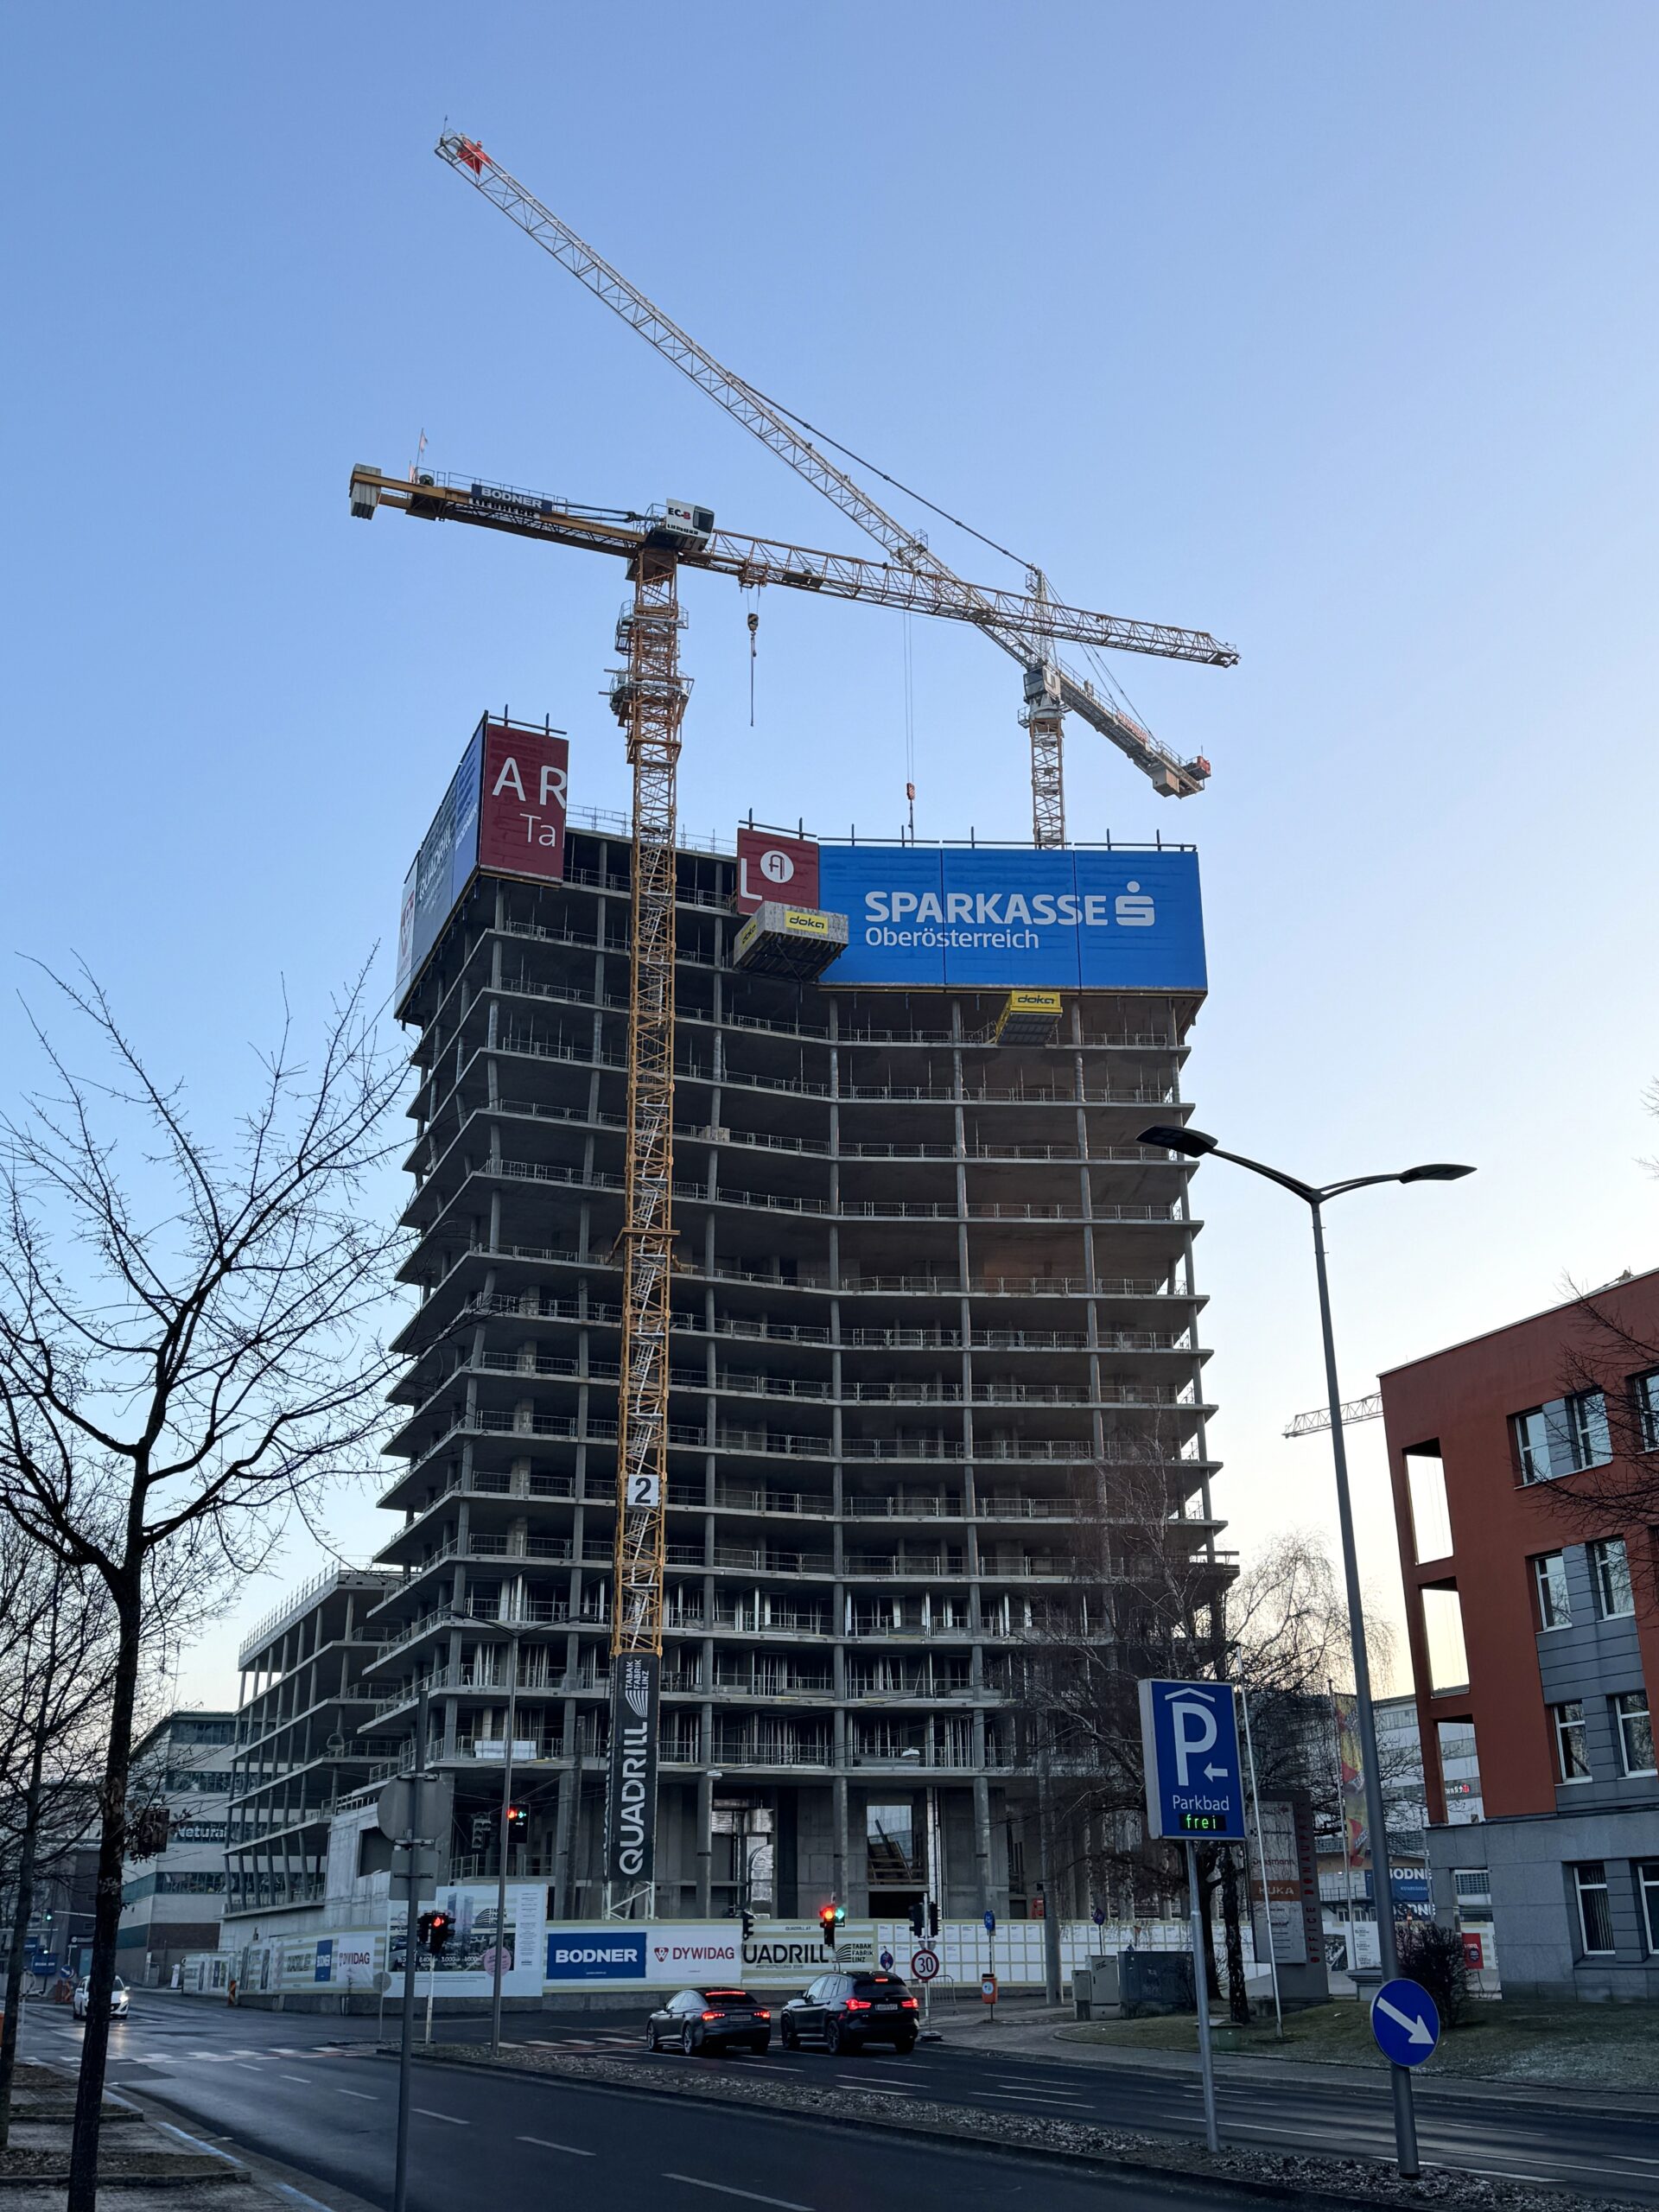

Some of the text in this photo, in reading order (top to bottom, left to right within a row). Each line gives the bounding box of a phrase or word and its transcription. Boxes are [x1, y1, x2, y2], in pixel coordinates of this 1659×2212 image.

[481, 486, 543, 509] BODNER
[668, 507, 691, 519] EC-B
[519, 813, 556, 848] Ta
[865, 891, 1109, 926] SPARKASSE
[789, 916, 824, 929] doka
[866, 927, 1039, 949] Oberösterreich
[1017, 995, 1054, 1004] doka
[634, 1478, 652, 1503] 2
[633, 1659, 642, 1689] FABRIK
[1172, 1701, 1217, 1786] P
[619, 1722, 648, 1875] QUADRILL
[1172, 1795, 1230, 1811] Parkbad
[1185, 1814, 1217, 1829] frei
[1306, 1906, 1320, 1963] OFFICE
[555, 1948, 638, 1963] BODNER
[672, 1947, 734, 1961] DYWIDAG
[918, 1956, 934, 1973] 30
